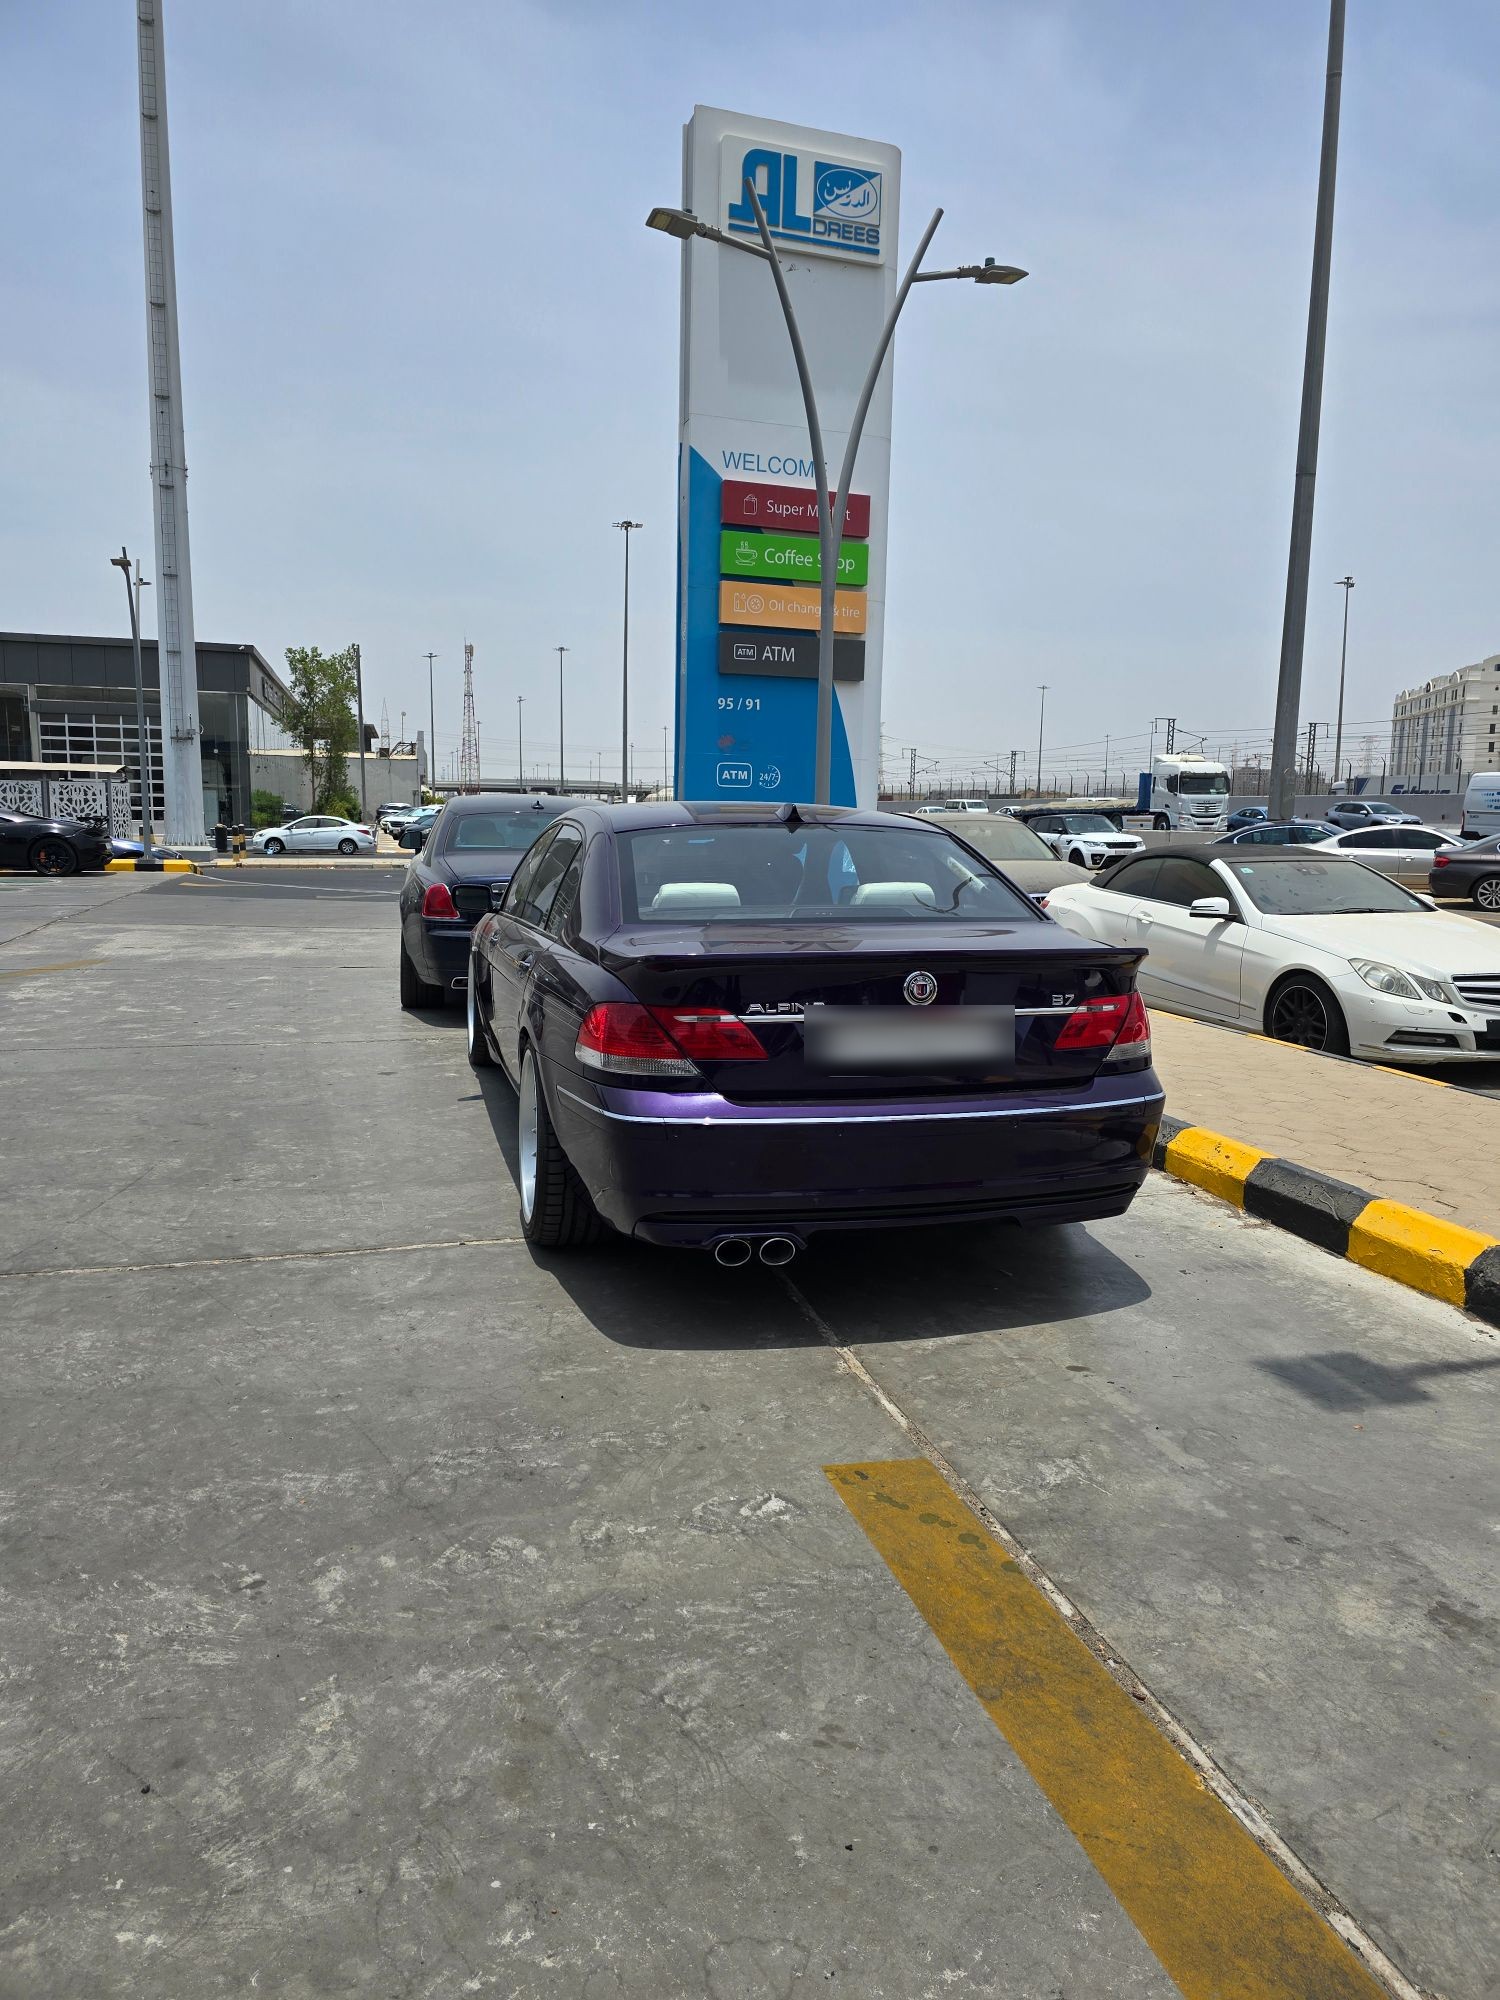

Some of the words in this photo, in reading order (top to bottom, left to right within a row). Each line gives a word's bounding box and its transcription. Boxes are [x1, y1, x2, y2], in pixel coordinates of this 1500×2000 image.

[728, 148, 811, 232] AL
[812, 217, 880, 245] DREES
[722, 450, 827, 478] WELCOM
[766, 500, 804, 517] Super
[764, 548, 813, 567] Coffee
[817, 552, 855, 574] Sop
[769, 599, 784, 612] Oil
[787, 602, 822, 617] chang
[842, 606, 860, 617] tire
[737, 647, 754, 656] ATM
[762, 646, 795, 662] ATM
[717, 697, 734, 710] 95
[745, 698, 761, 711] 91
[722, 770, 748, 780] ATM
[759, 773, 776, 782] 24/7
[746, 1002, 825, 1014] ALPIN
[1052, 994, 1075, 1006] B7
